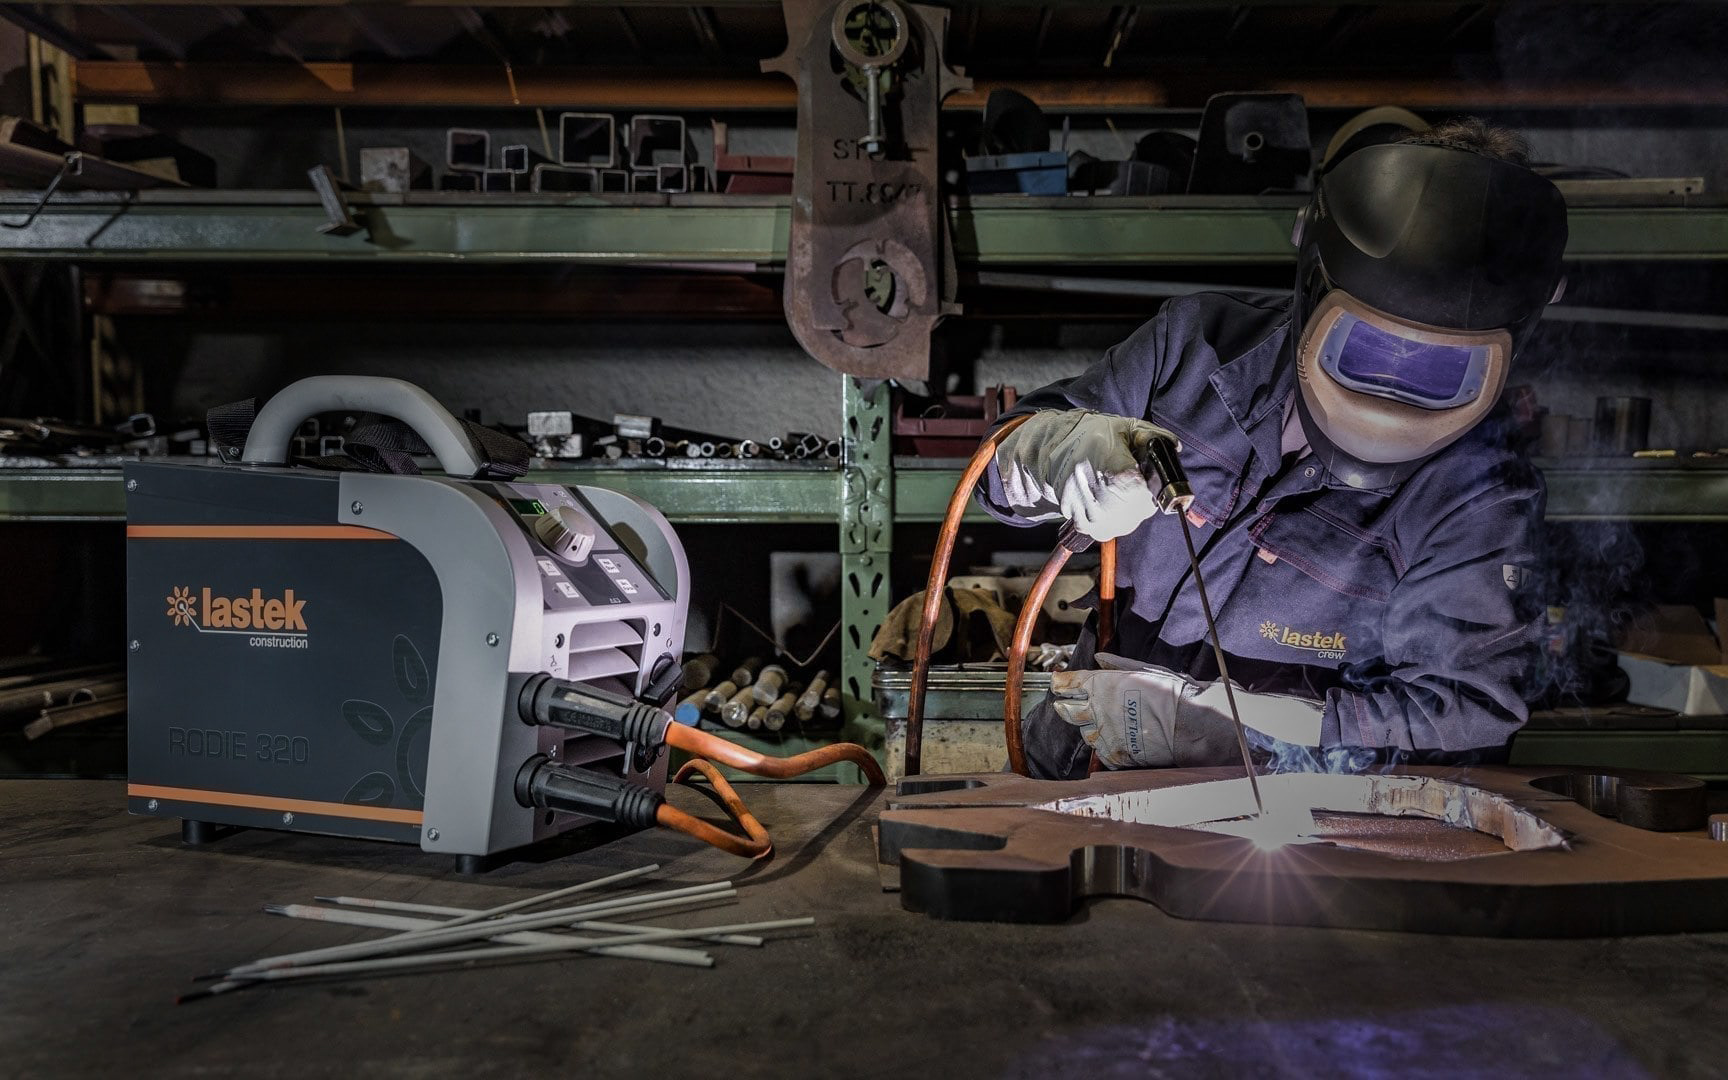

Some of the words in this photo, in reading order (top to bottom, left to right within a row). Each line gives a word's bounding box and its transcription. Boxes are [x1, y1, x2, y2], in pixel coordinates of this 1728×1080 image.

[202, 587, 308, 630] lastek
[249, 636, 308, 649] construction
[1281, 627, 1346, 649] lastek
[1317, 650, 1345, 660] crew
[168, 726, 248, 760] RODIE
[256, 733, 311, 765] 320
